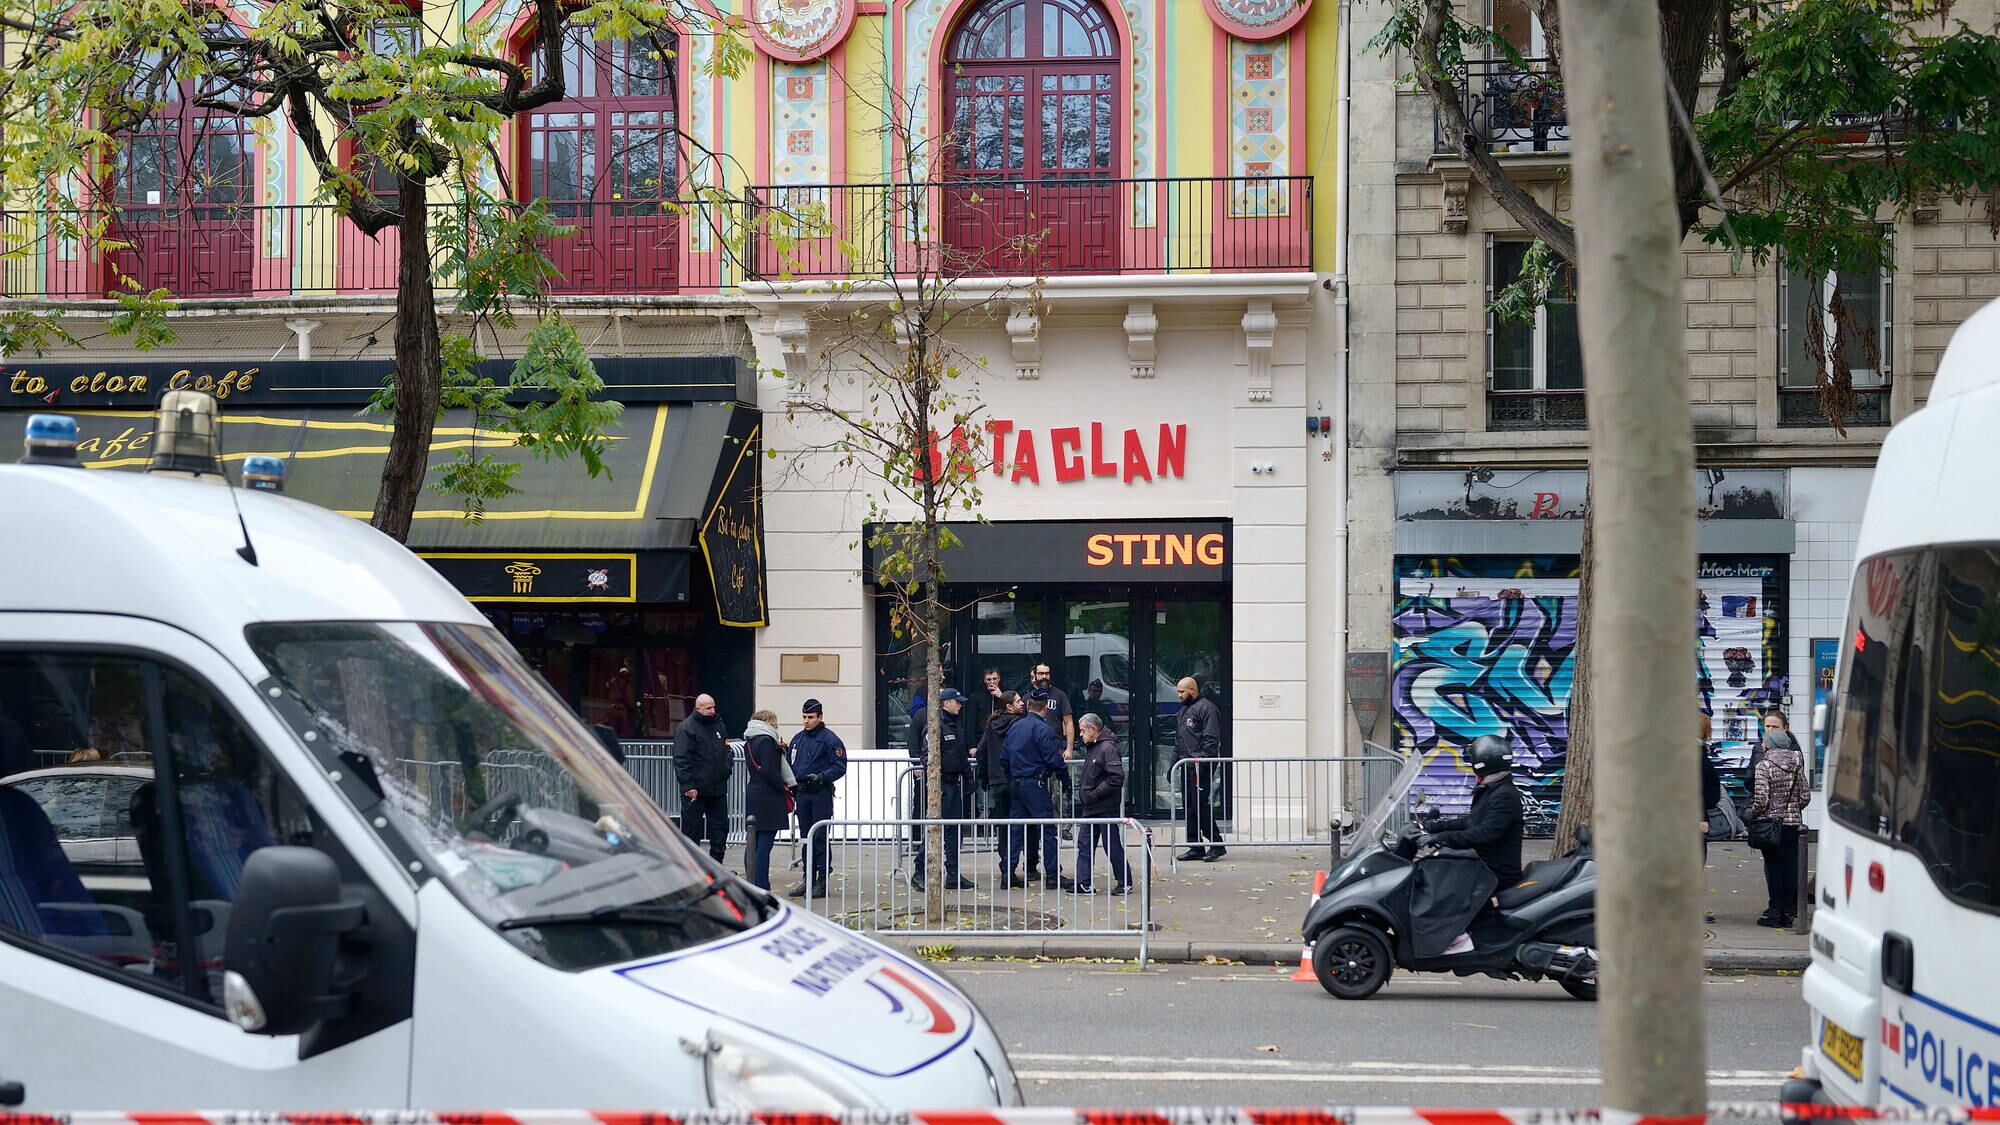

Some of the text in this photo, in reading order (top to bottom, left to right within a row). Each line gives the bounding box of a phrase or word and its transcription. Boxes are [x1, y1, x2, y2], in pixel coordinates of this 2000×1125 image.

[70, 370, 148, 394] clan
[169, 367, 260, 400] Café
[76, 427, 155, 459] afé
[1087, 532, 1225, 567] STING
[761, 926, 828, 963] POLICE
[791, 941, 879, 998] NATIONALE
[1904, 1021, 2000, 1108] POLICE
